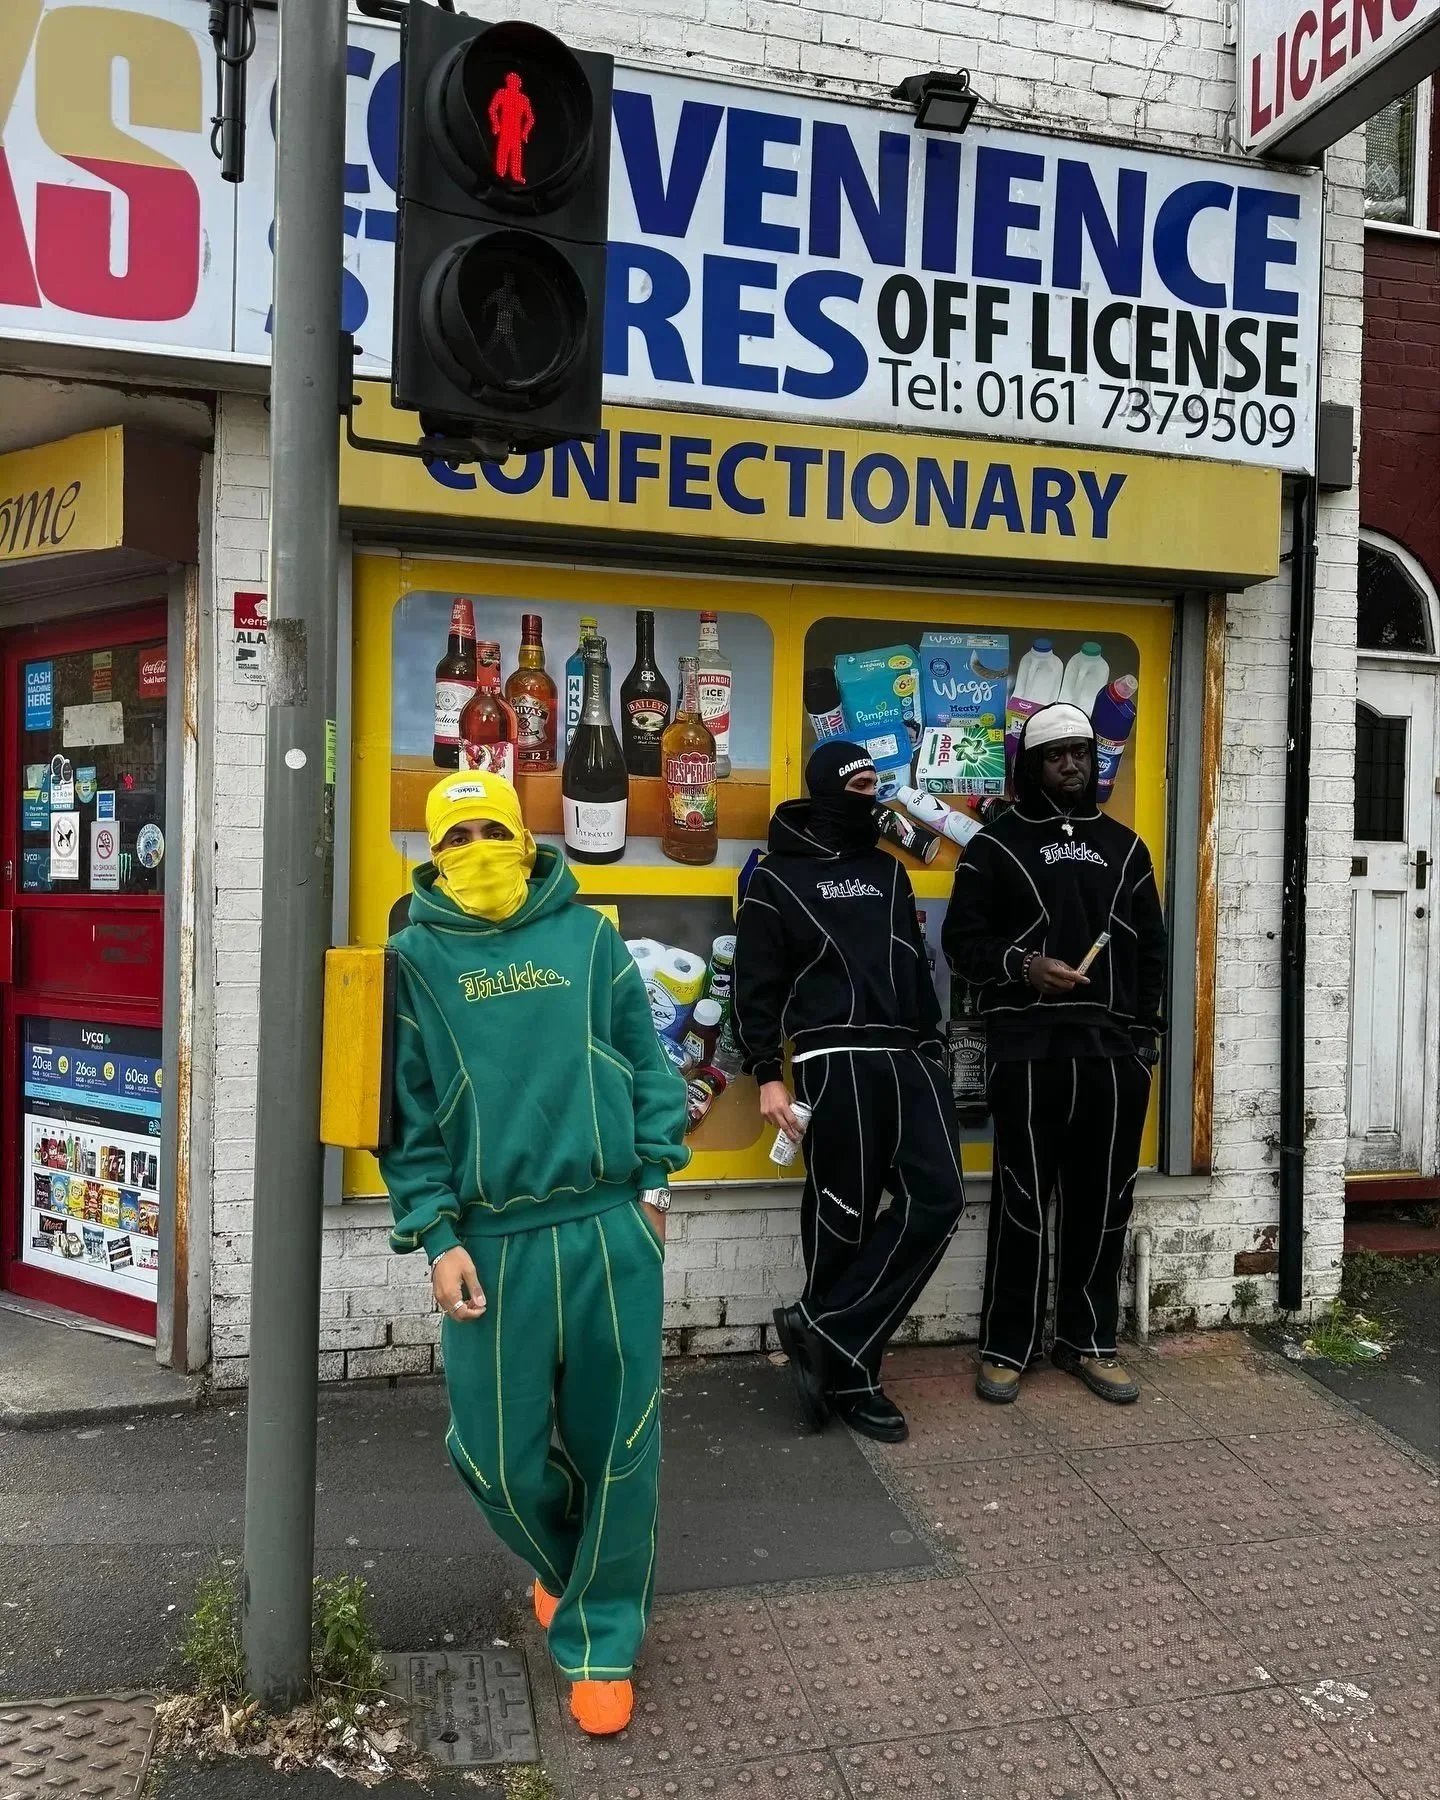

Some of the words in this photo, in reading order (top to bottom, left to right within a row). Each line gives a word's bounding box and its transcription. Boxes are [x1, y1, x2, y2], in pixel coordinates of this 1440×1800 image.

[1251, 0, 1417, 137] LICEN
[270, 45, 1301, 316] VENIENCE
[877, 274, 1009, 363] OFF
[1032, 293, 1298, 398] LICENSE
[878, 358, 962, 414] Tel:
[977, 373, 1077, 426] 0161
[1101, 384, 1295, 448] 7379509
[929, 635, 962, 645] Wagg
[28, 671, 51, 685] CASH
[144, 676, 154, 684] Sold
[28, 684, 51, 693] MACHINE
[706, 689, 722, 697] ICE
[933, 677, 998, 704] Wagg
[28, 693, 51, 707] HERE
[569, 678, 580, 722] WKD
[628, 699, 668, 715] BAILEYS
[513, 705, 543, 718] HIVAS
[856, 707, 899, 723] Pampers
[950, 704, 981, 712] Meaty
[531, 752, 541, 760] 12
[937, 733, 952, 767] ARIEL
[878, 809, 892, 828] YNX
[82, 1029, 104, 1044] Lyca
[949, 1039, 964, 1053] JACK
[32, 1055, 52, 1070] 20GB
[75, 1061, 97, 1077] 26GB
[125, 1068, 149, 1084] 60GB
